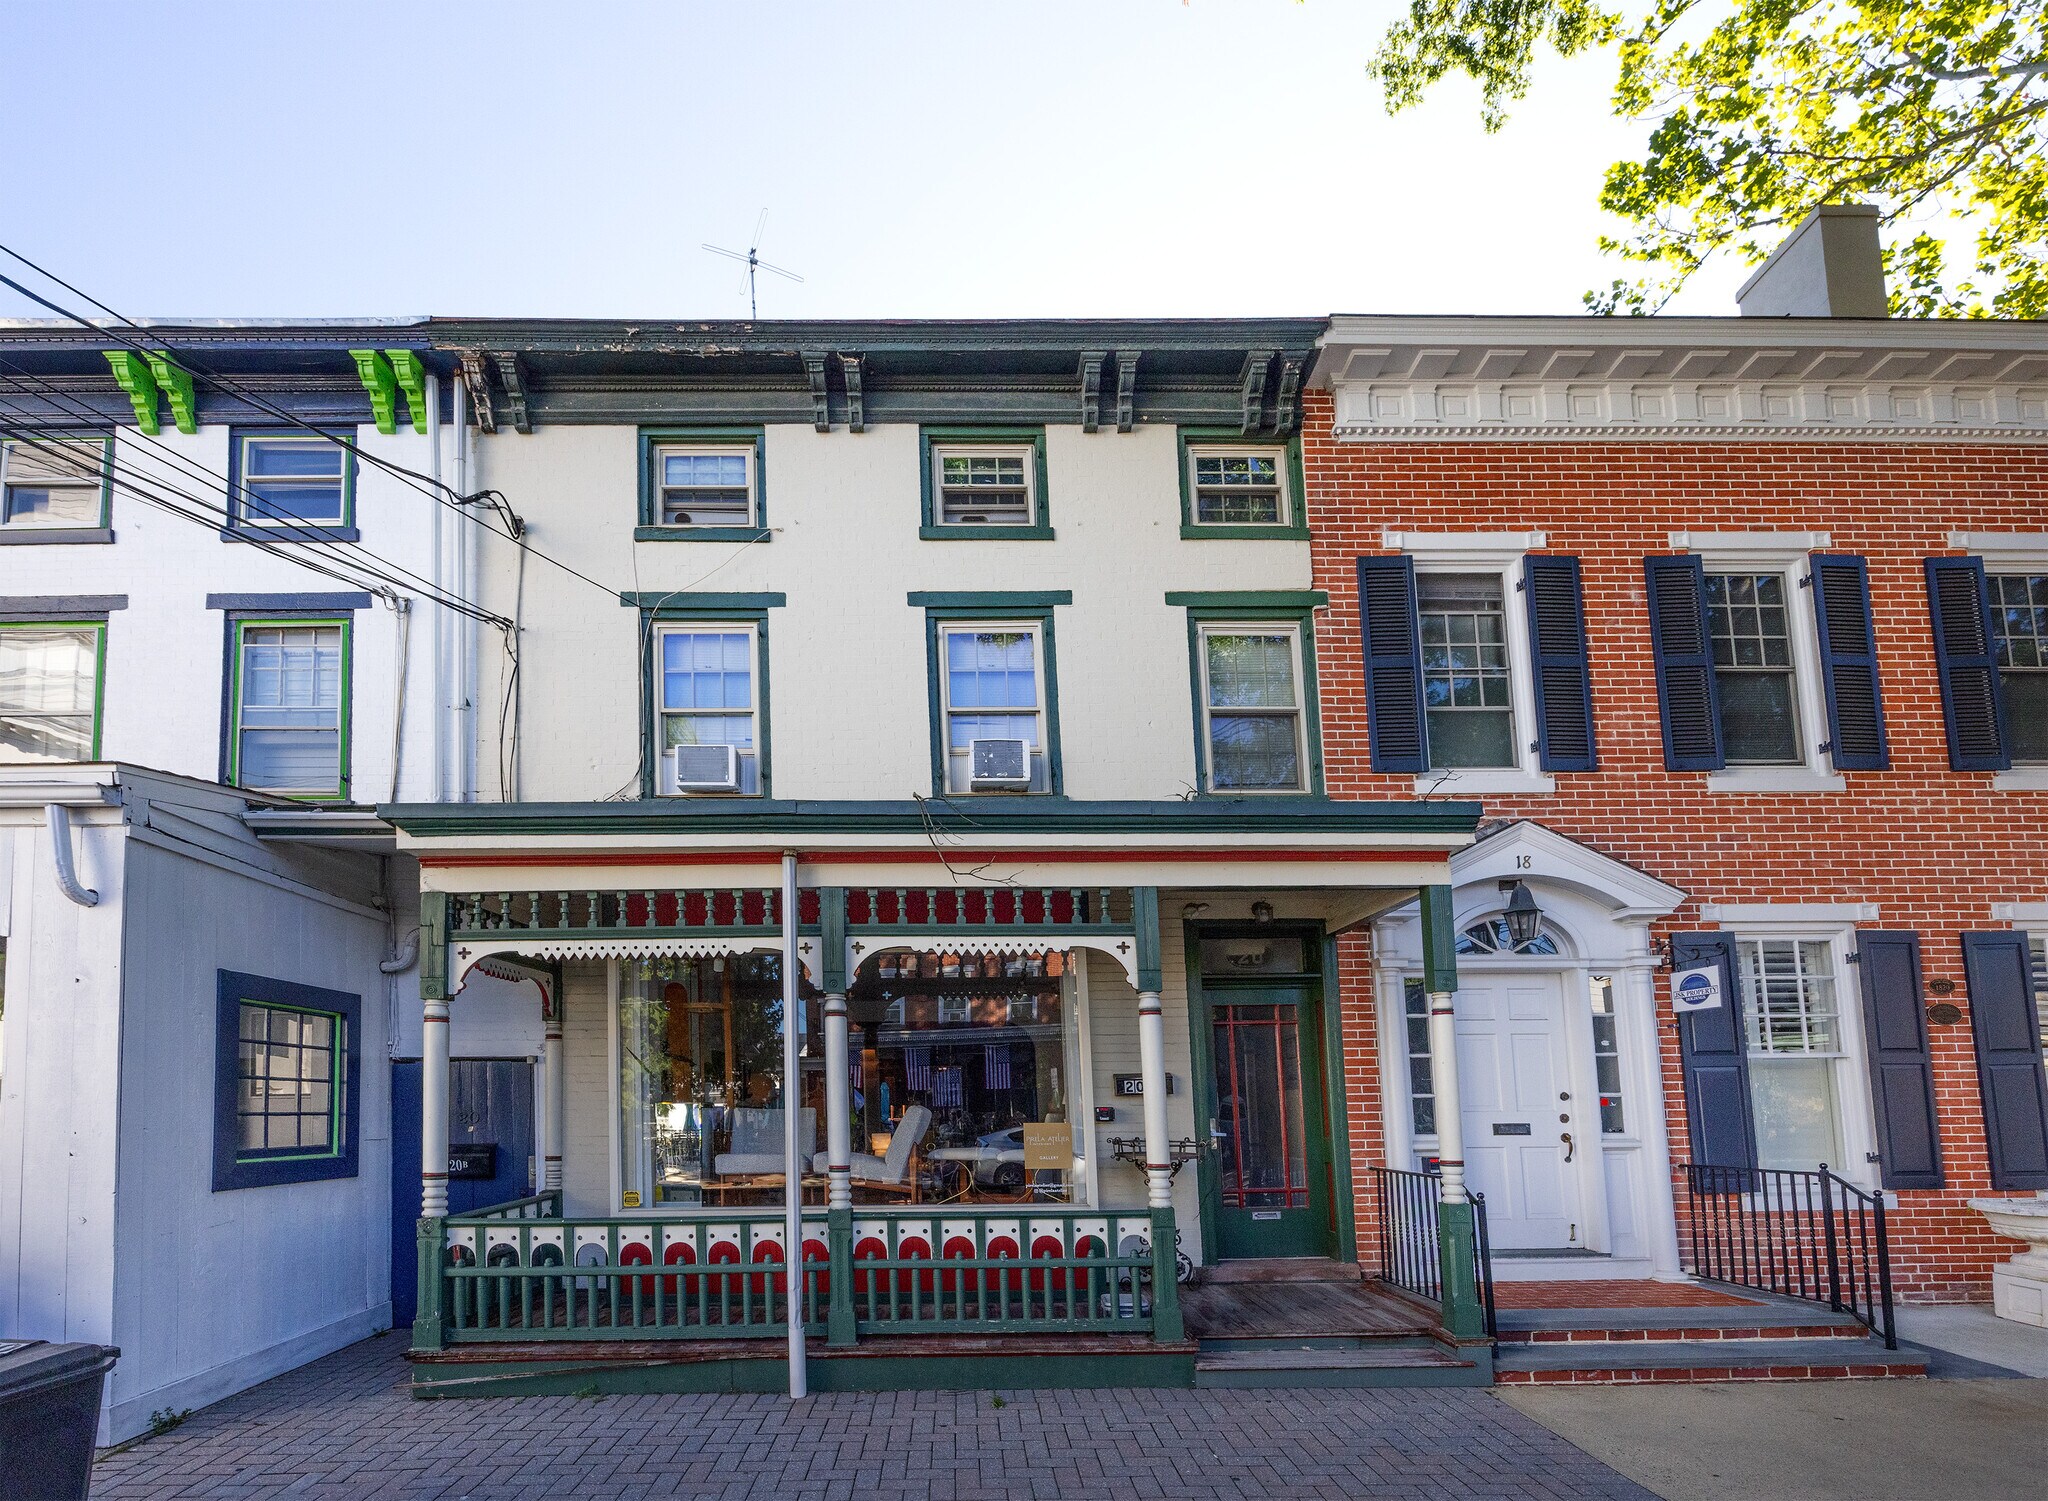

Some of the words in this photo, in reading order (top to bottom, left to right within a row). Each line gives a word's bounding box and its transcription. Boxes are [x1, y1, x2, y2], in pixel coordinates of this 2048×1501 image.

[1516, 855, 1531, 869] 18
[1686, 986, 1718, 998] PROPERTY
[1125, 1081, 1144, 1093] 20
[449, 1159, 469, 1171] 20B
